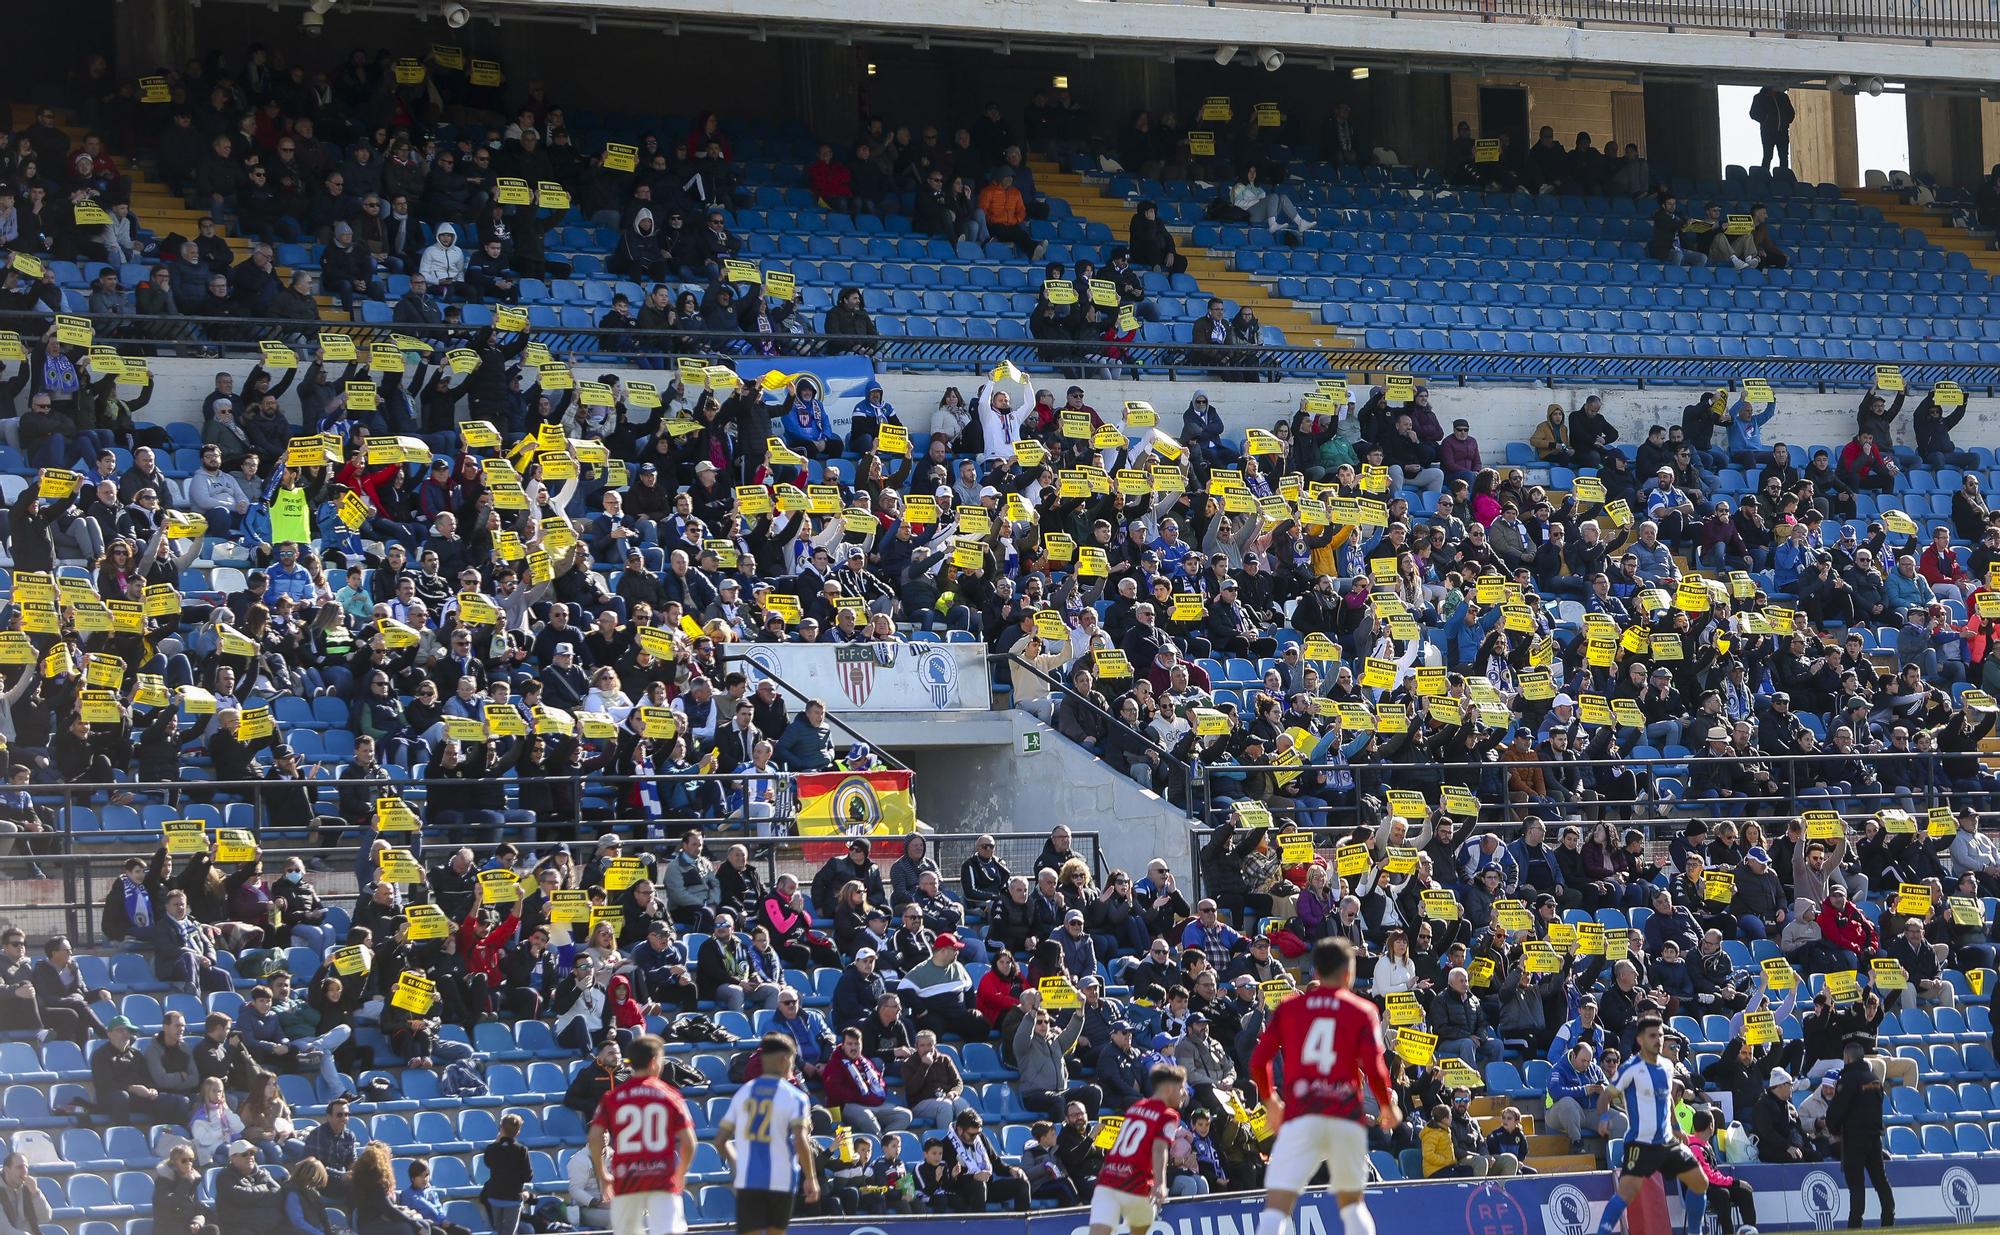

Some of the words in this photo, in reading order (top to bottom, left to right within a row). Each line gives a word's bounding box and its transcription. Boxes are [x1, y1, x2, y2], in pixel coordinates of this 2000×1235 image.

[1301, 1017, 1337, 1075] 4
[616, 1103, 668, 1154] 20
[743, 1098, 773, 1143] 22
[1109, 1118, 1148, 1158] 10
[1628, 1146, 1640, 1160] 10
